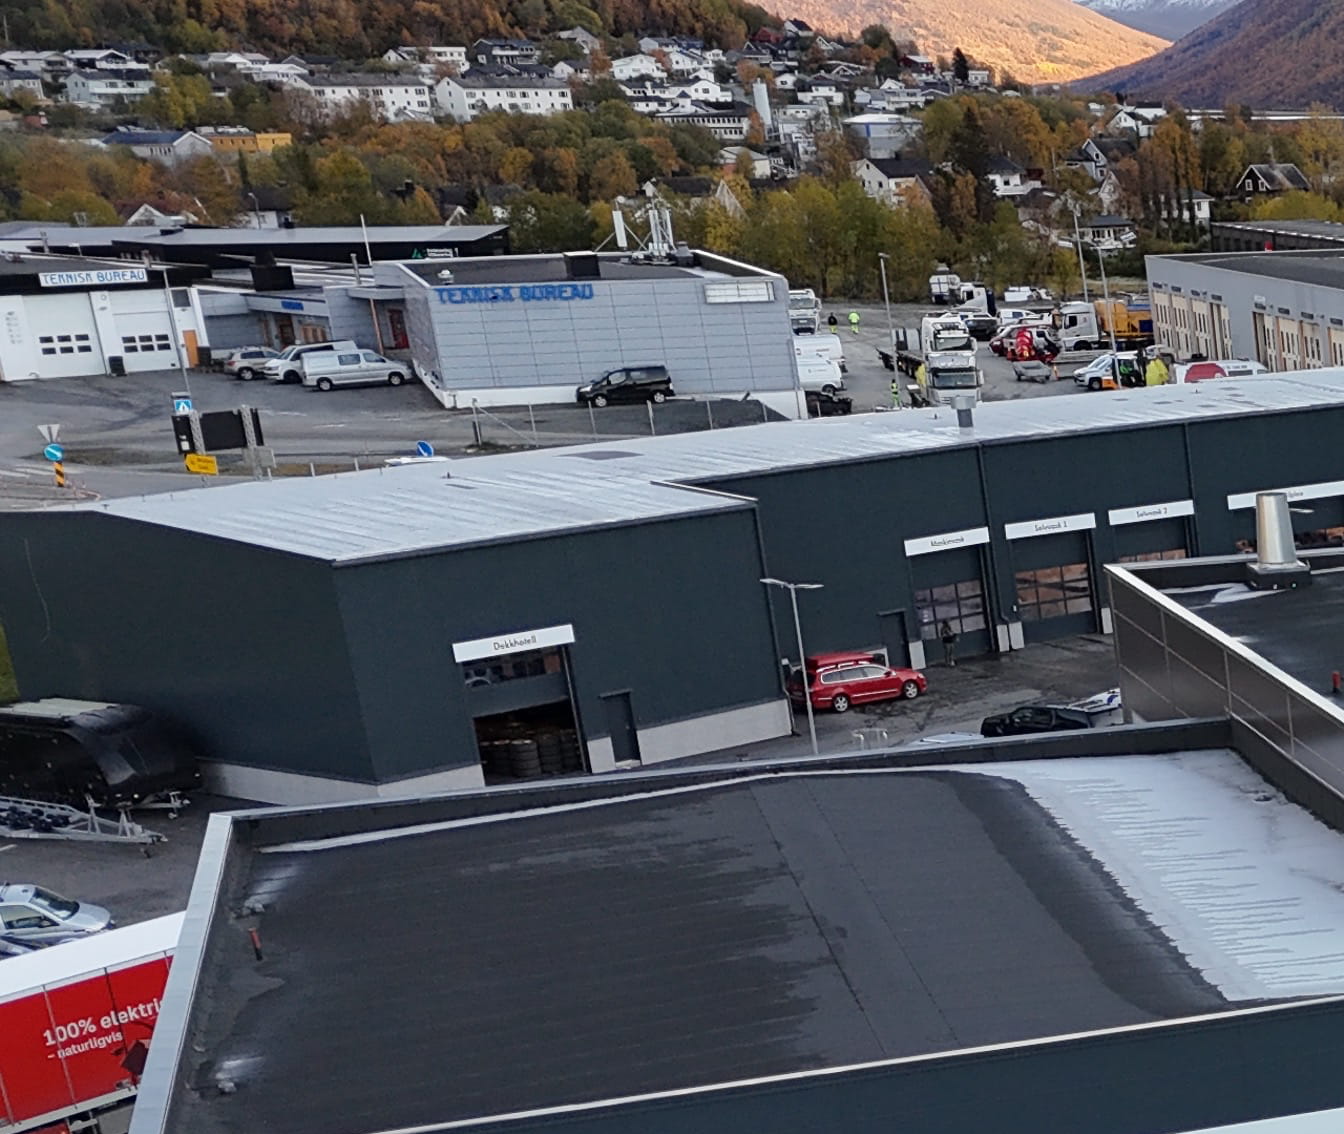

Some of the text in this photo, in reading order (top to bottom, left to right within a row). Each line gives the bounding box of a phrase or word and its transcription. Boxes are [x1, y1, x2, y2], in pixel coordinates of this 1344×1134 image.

[96, 269, 145, 282] BUREAU
[519, 283, 594, 301] BUREAU
[492, 634, 538, 651] Dekkhotell
[43, 998, 162, 1046] 100% elektri
[57, 1031, 123, 1059] naturligvis
